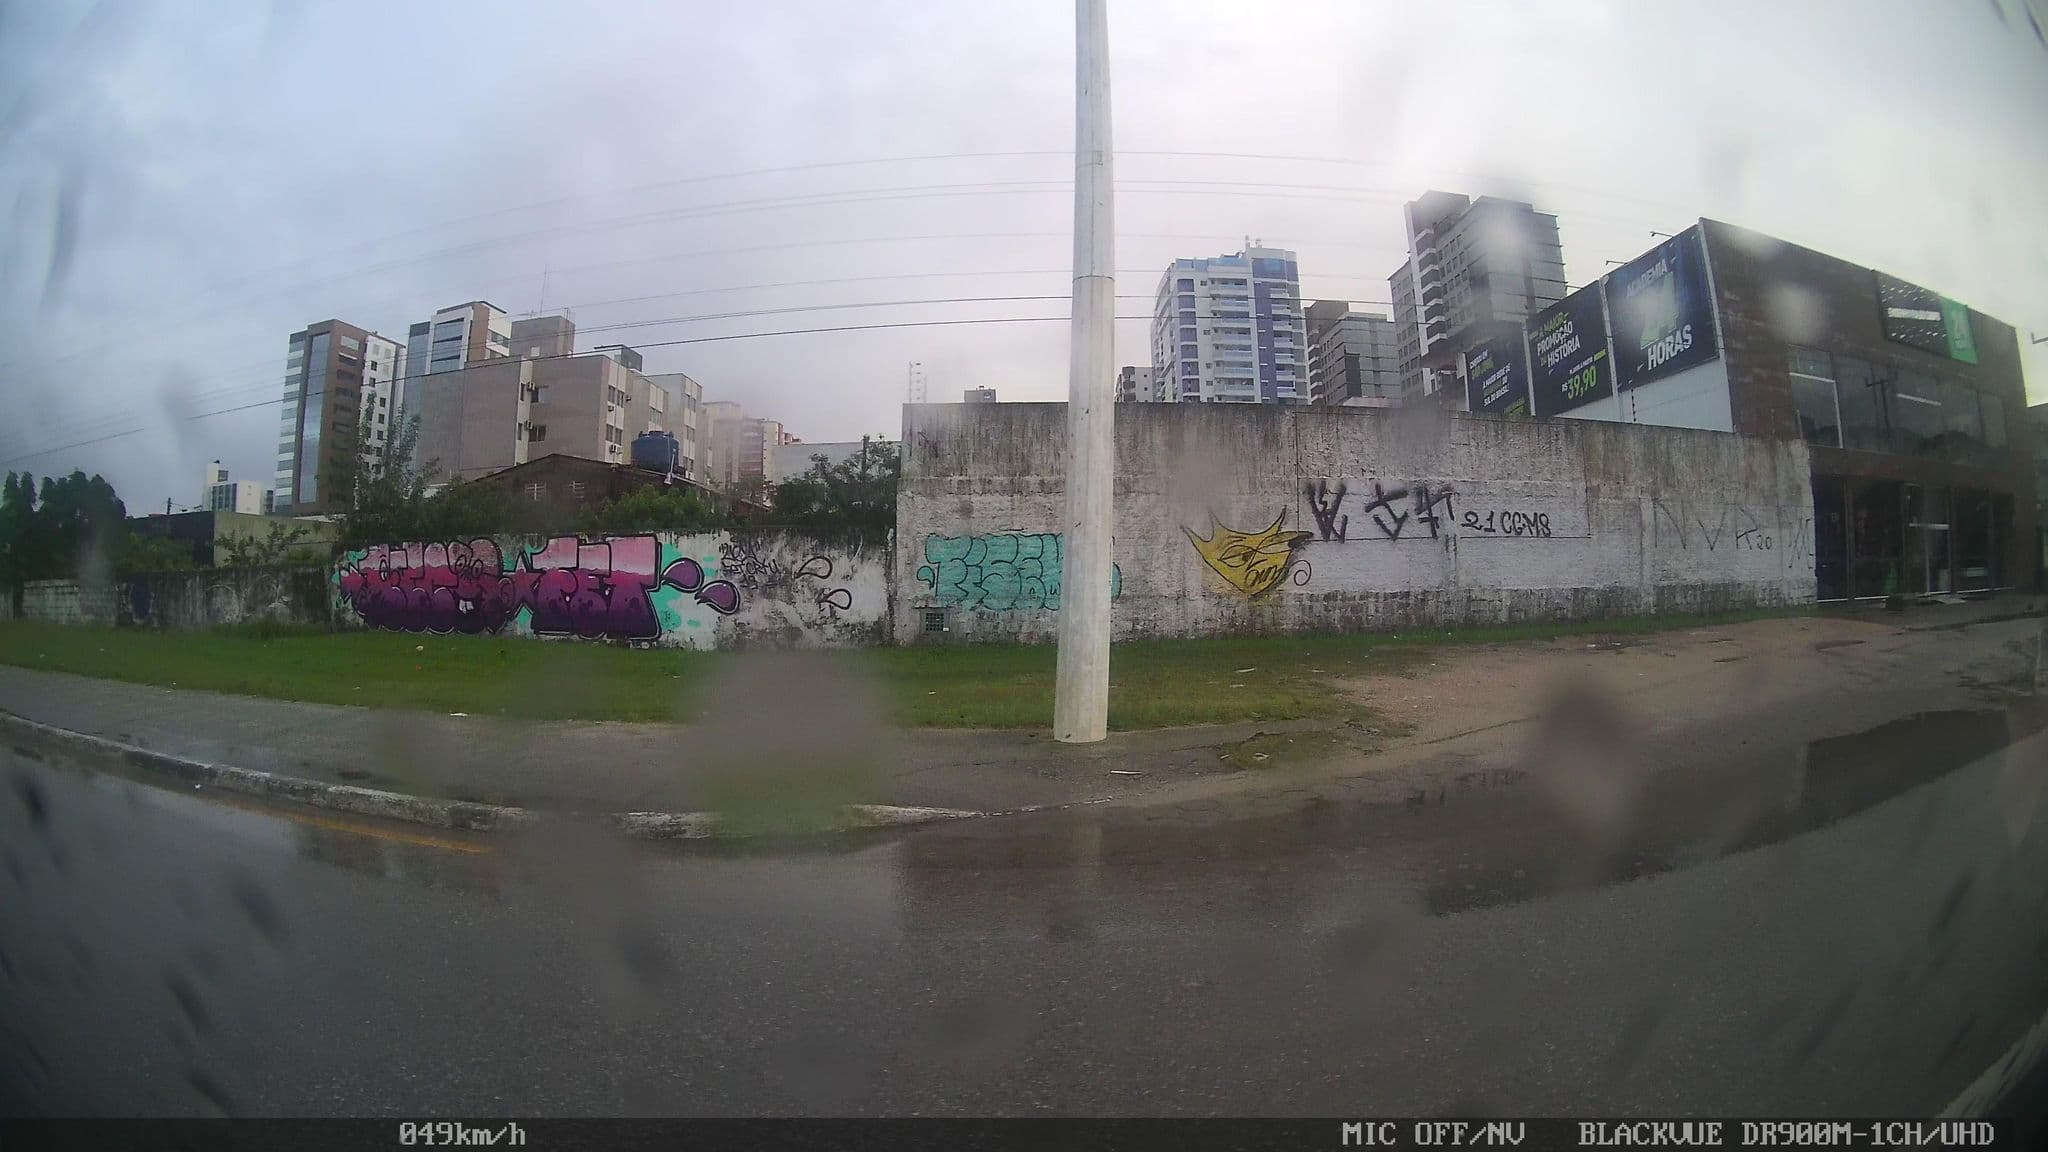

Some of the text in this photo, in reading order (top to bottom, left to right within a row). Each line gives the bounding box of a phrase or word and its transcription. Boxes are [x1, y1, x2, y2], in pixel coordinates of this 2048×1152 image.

[1626, 258, 1668, 297] ACADEMIA
[1537, 320, 1573, 356] PROMOÇÃO
[1547, 334, 1581, 368] HISTÓRIA
[1647, 323, 1693, 371] HORAS
[1567, 365, 1597, 400] 39,90
